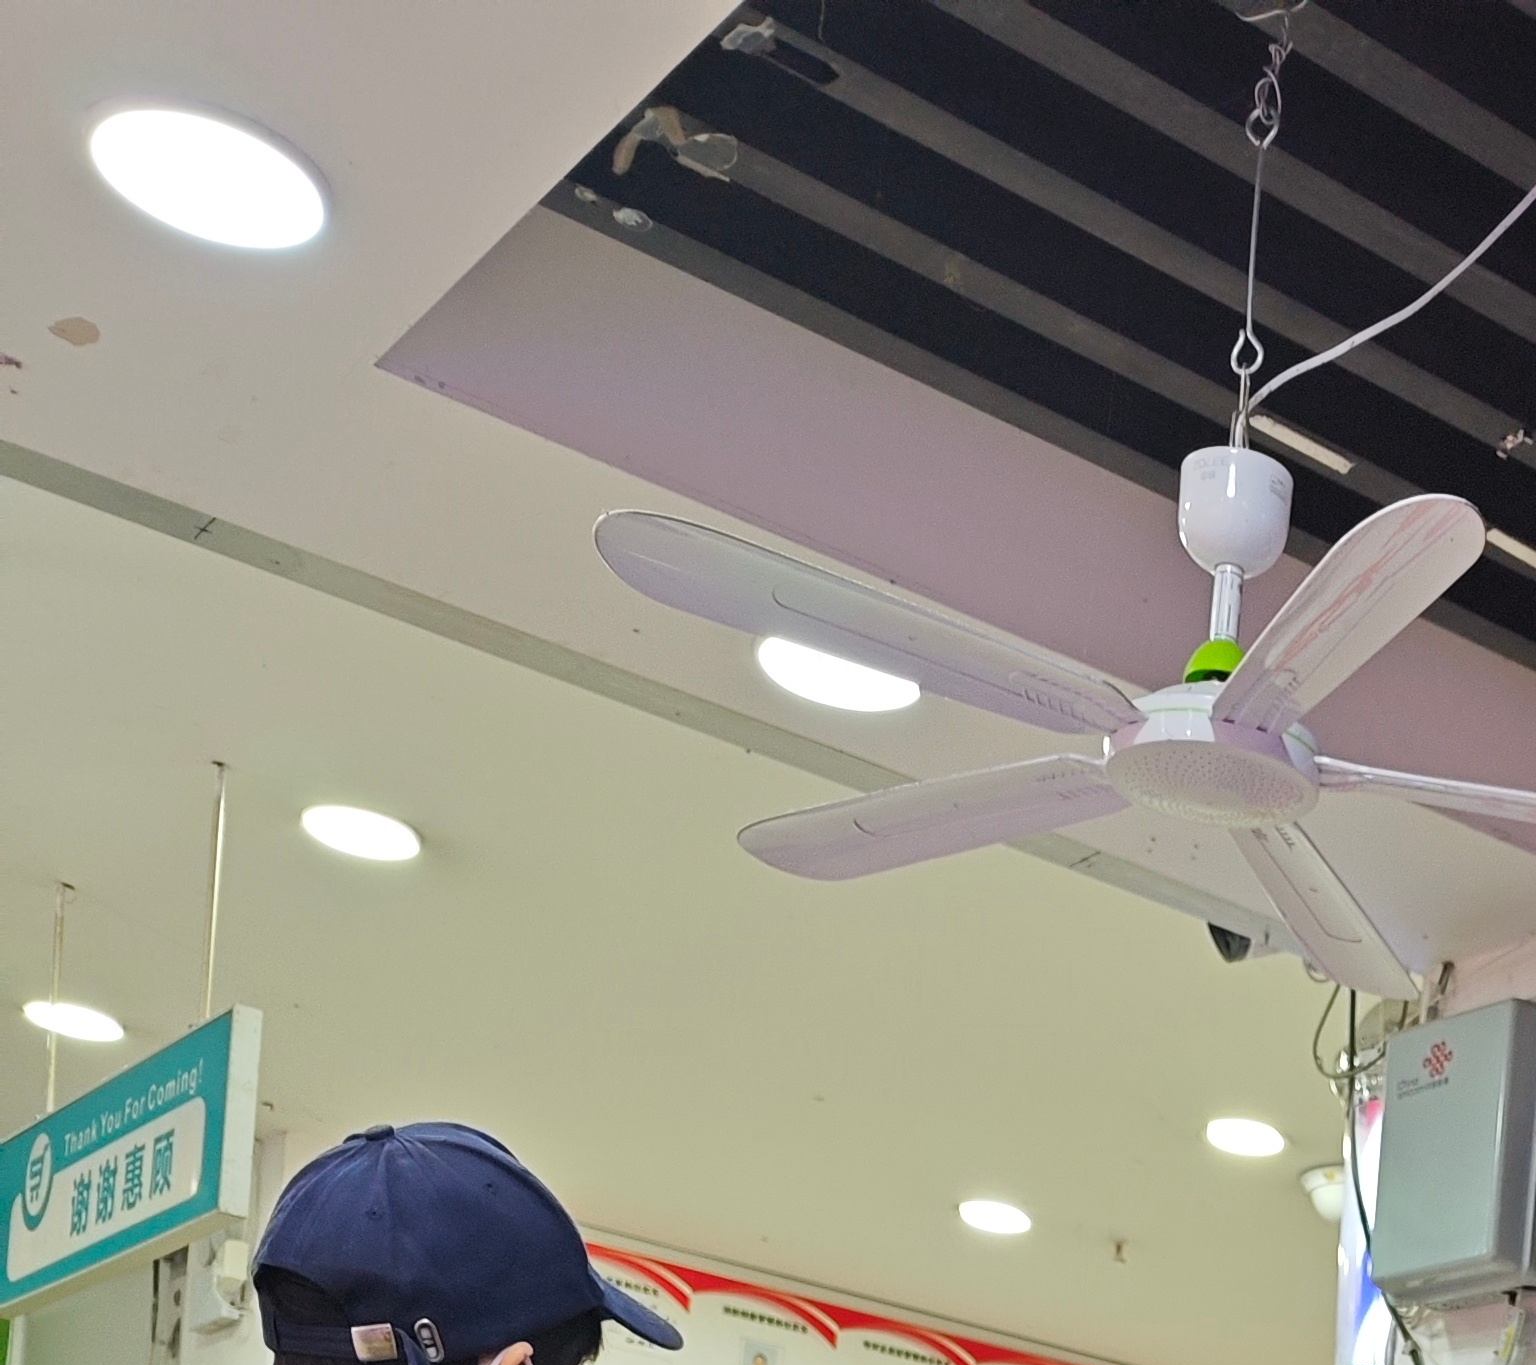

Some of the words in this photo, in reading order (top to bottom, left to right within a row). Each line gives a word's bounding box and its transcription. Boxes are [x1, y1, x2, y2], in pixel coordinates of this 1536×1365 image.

[64, 1121, 98, 1156] Thank
[101, 1110, 121, 1136] You
[124, 1096, 146, 1126] For
[147, 1058, 204, 1110] Coming!
[69, 1128, 175, 1237] 谢谢惠顾
